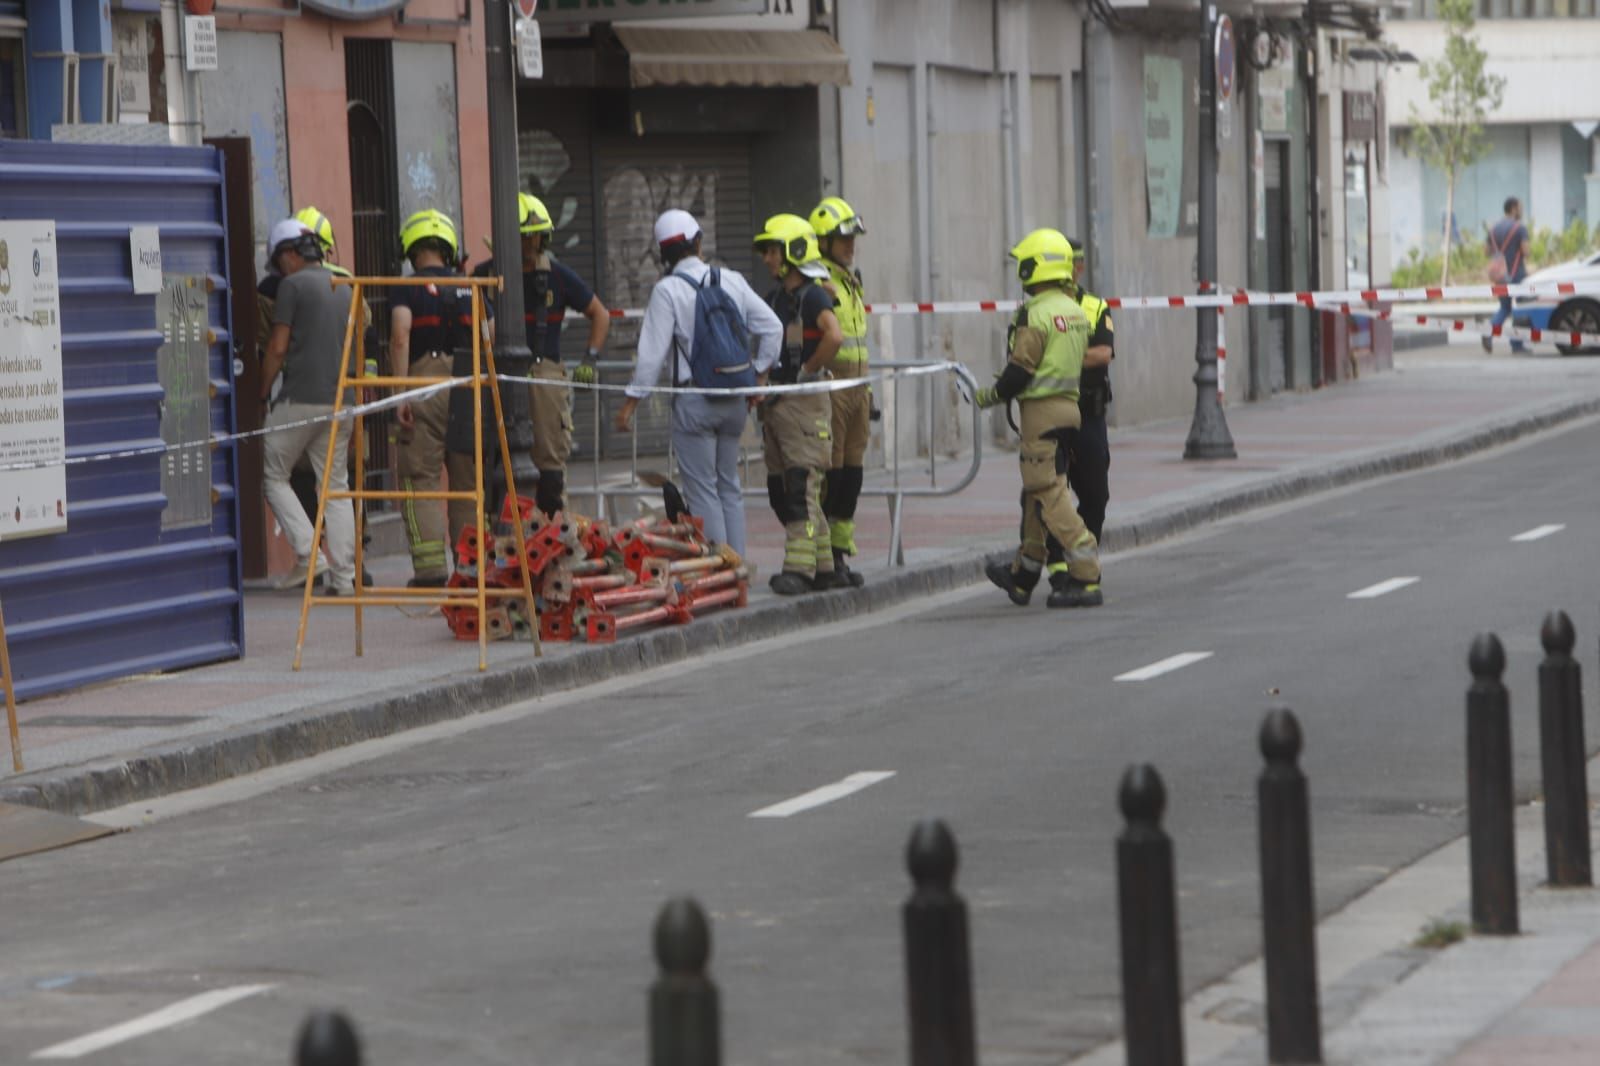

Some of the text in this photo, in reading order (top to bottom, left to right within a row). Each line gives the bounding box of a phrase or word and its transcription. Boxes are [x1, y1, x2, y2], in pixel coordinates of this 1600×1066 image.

[26, 382, 39, 400] para
[40, 378, 58, 396] cubrir
[14, 407, 24, 423] tus
[25, 403, 59, 422] necesidades
